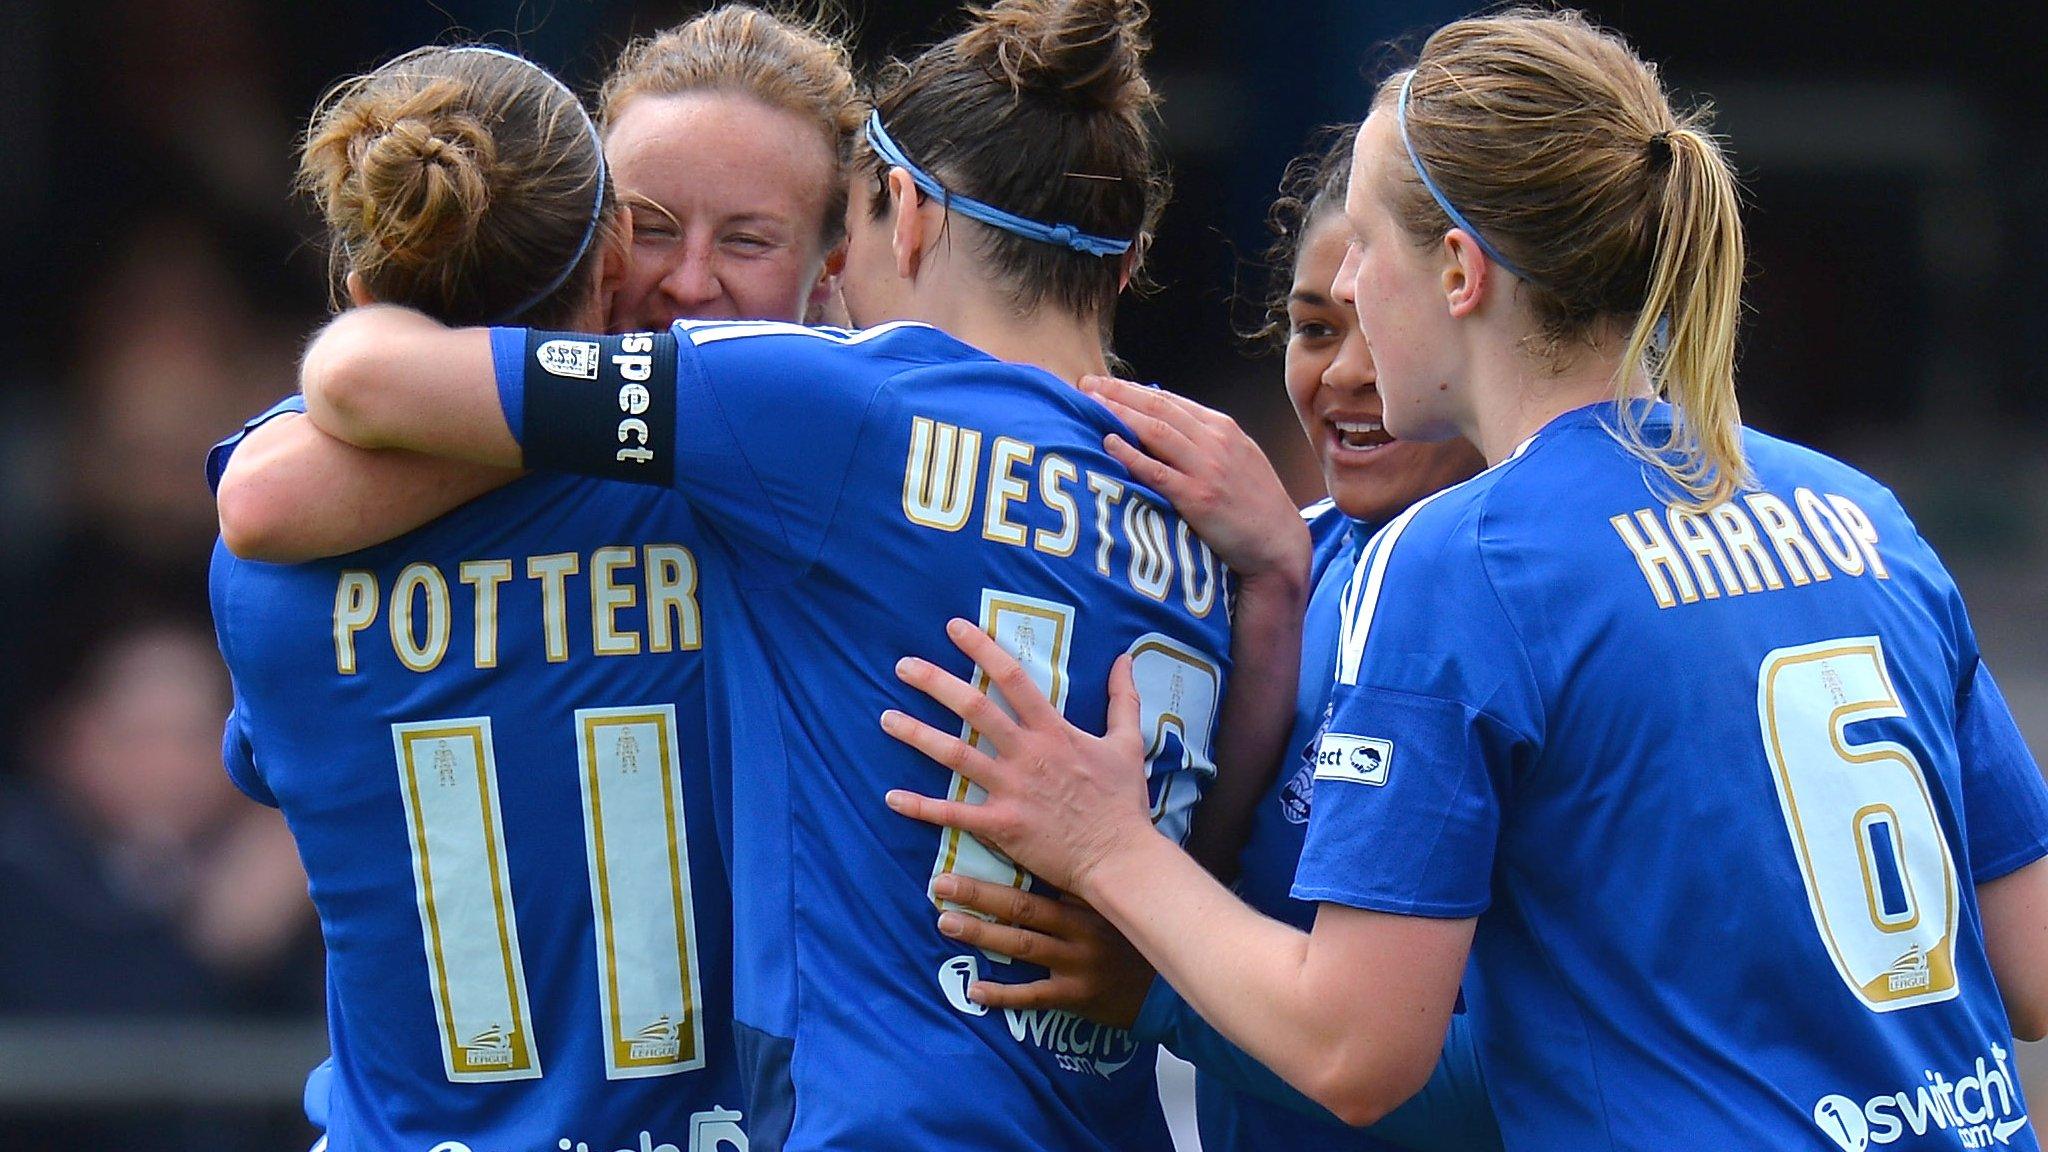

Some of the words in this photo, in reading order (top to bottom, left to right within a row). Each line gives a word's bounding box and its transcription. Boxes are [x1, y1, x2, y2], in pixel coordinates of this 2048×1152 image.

[333, 544, 702, 675] POTTER
[902, 416, 1235, 625] WESTWO
[1609, 487, 1889, 610] HARROP
[391, 703, 706, 1083] 11
[1757, 635, 1960, 1013] 6
